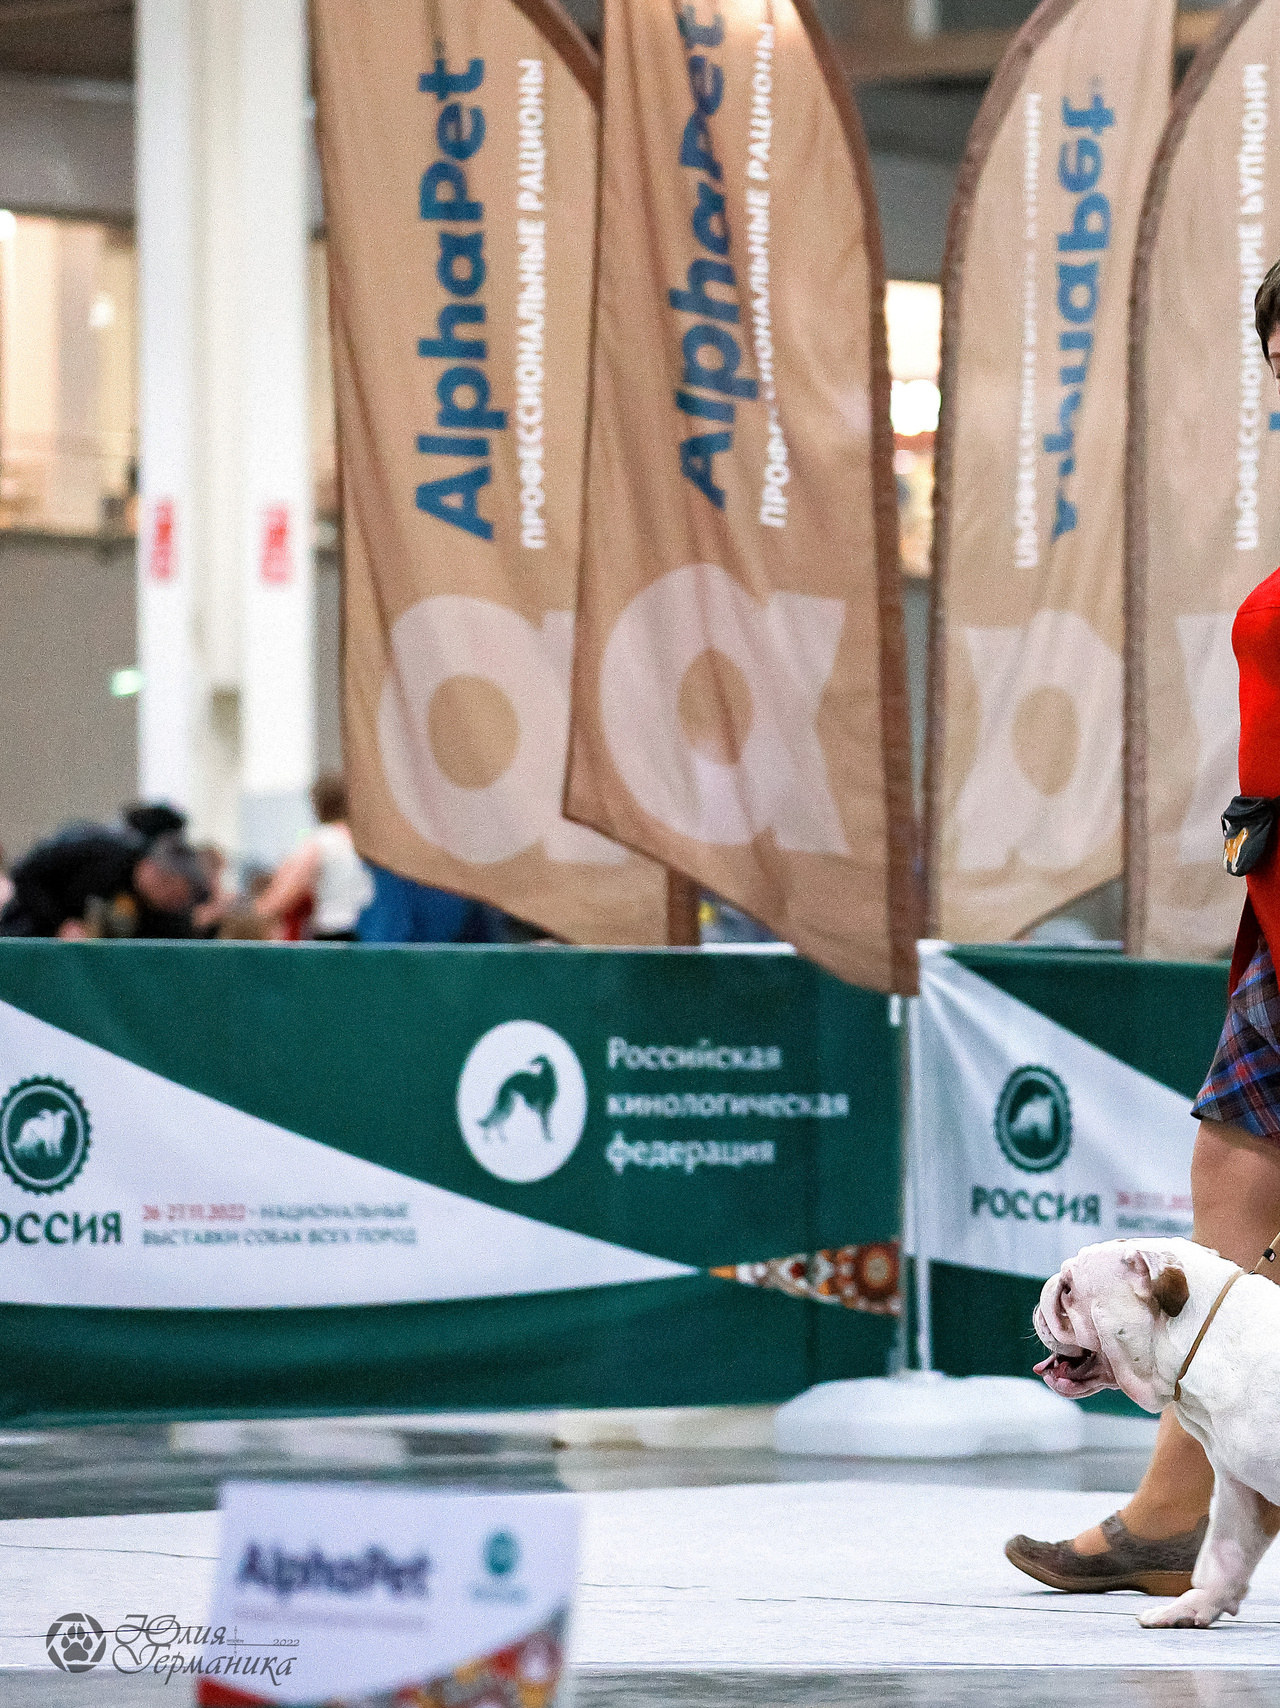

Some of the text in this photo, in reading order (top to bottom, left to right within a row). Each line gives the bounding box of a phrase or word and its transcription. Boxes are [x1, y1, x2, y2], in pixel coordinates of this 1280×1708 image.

[415, 57, 507, 541] AlphaPet
[516, 59, 546, 549] ПРОФЕССИОНАЛЬНЫЕ РАЦИОНЫ
[607, 1036, 782, 1070] Российская
[607, 1094, 850, 1118] кинологическая
[606, 1132, 776, 1174] федерация
[971, 1186, 1099, 1226] РОССИЯ
